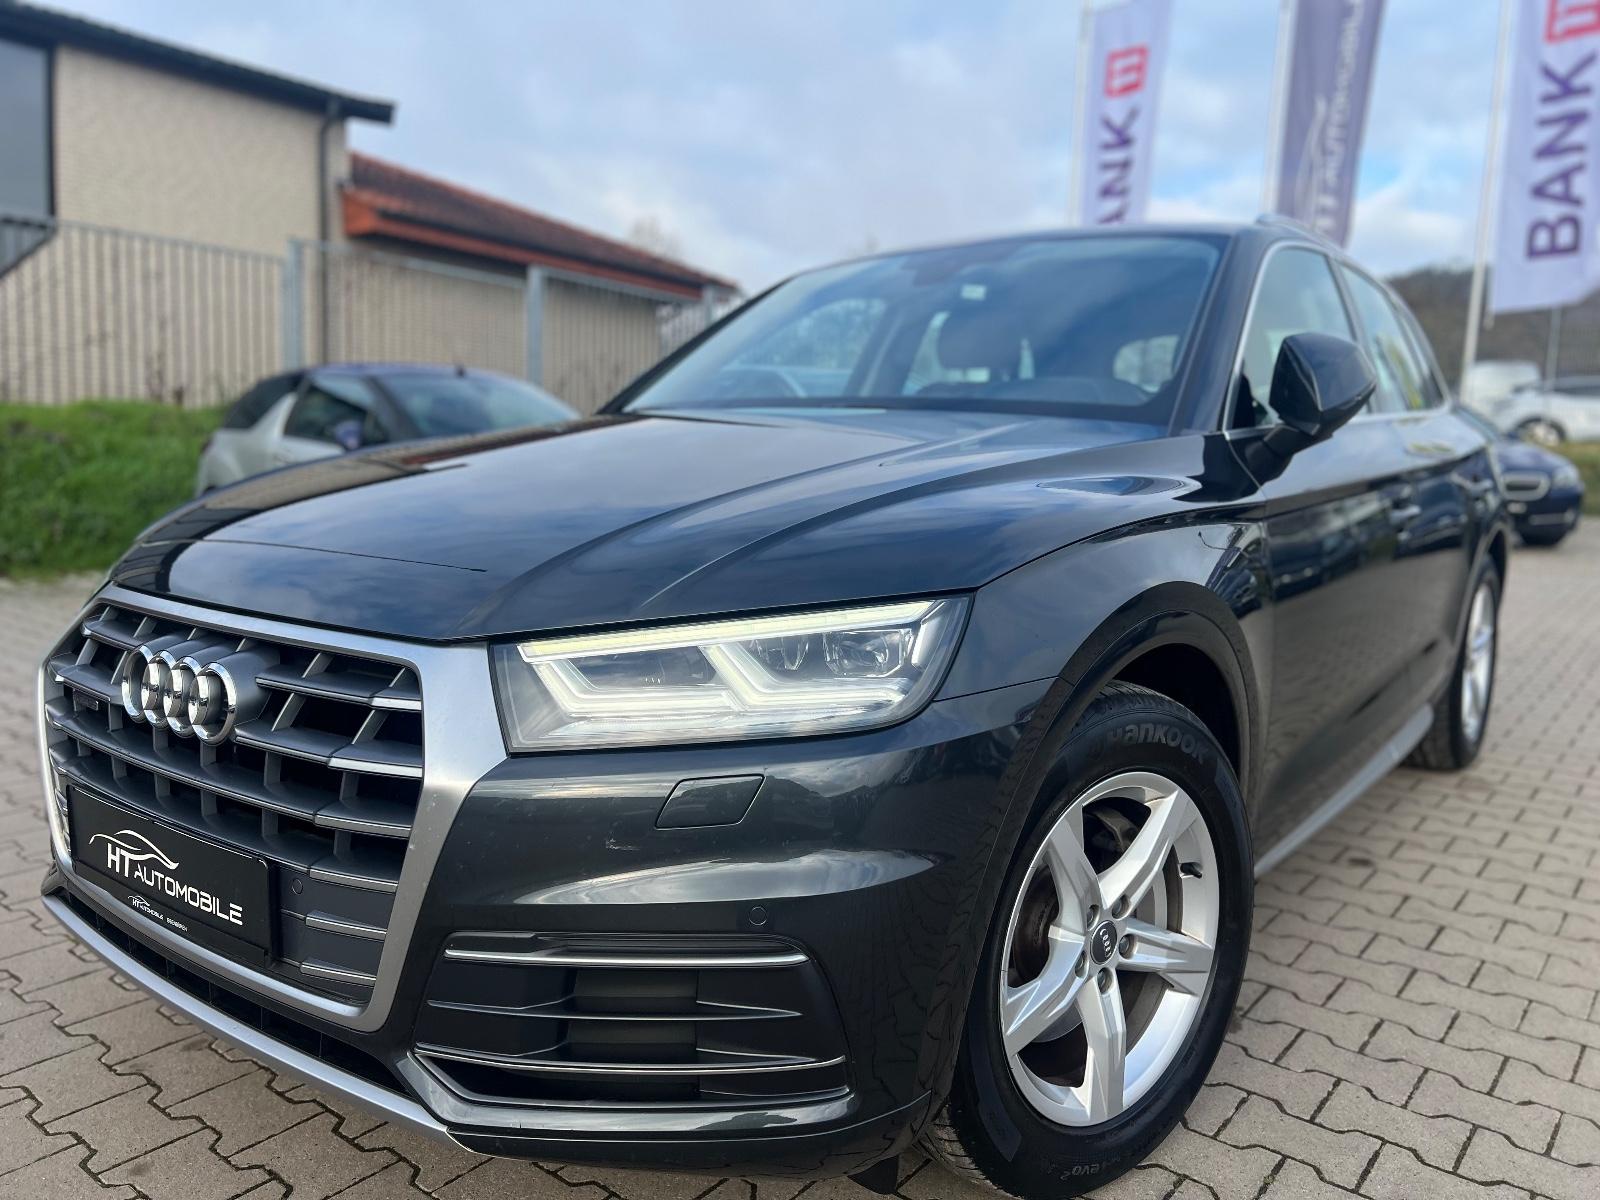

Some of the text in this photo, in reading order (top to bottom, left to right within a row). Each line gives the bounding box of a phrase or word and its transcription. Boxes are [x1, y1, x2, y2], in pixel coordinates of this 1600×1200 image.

[1526, 51, 1598, 261] BANK
[107, 842, 243, 926] HT AUTOMOBILE
